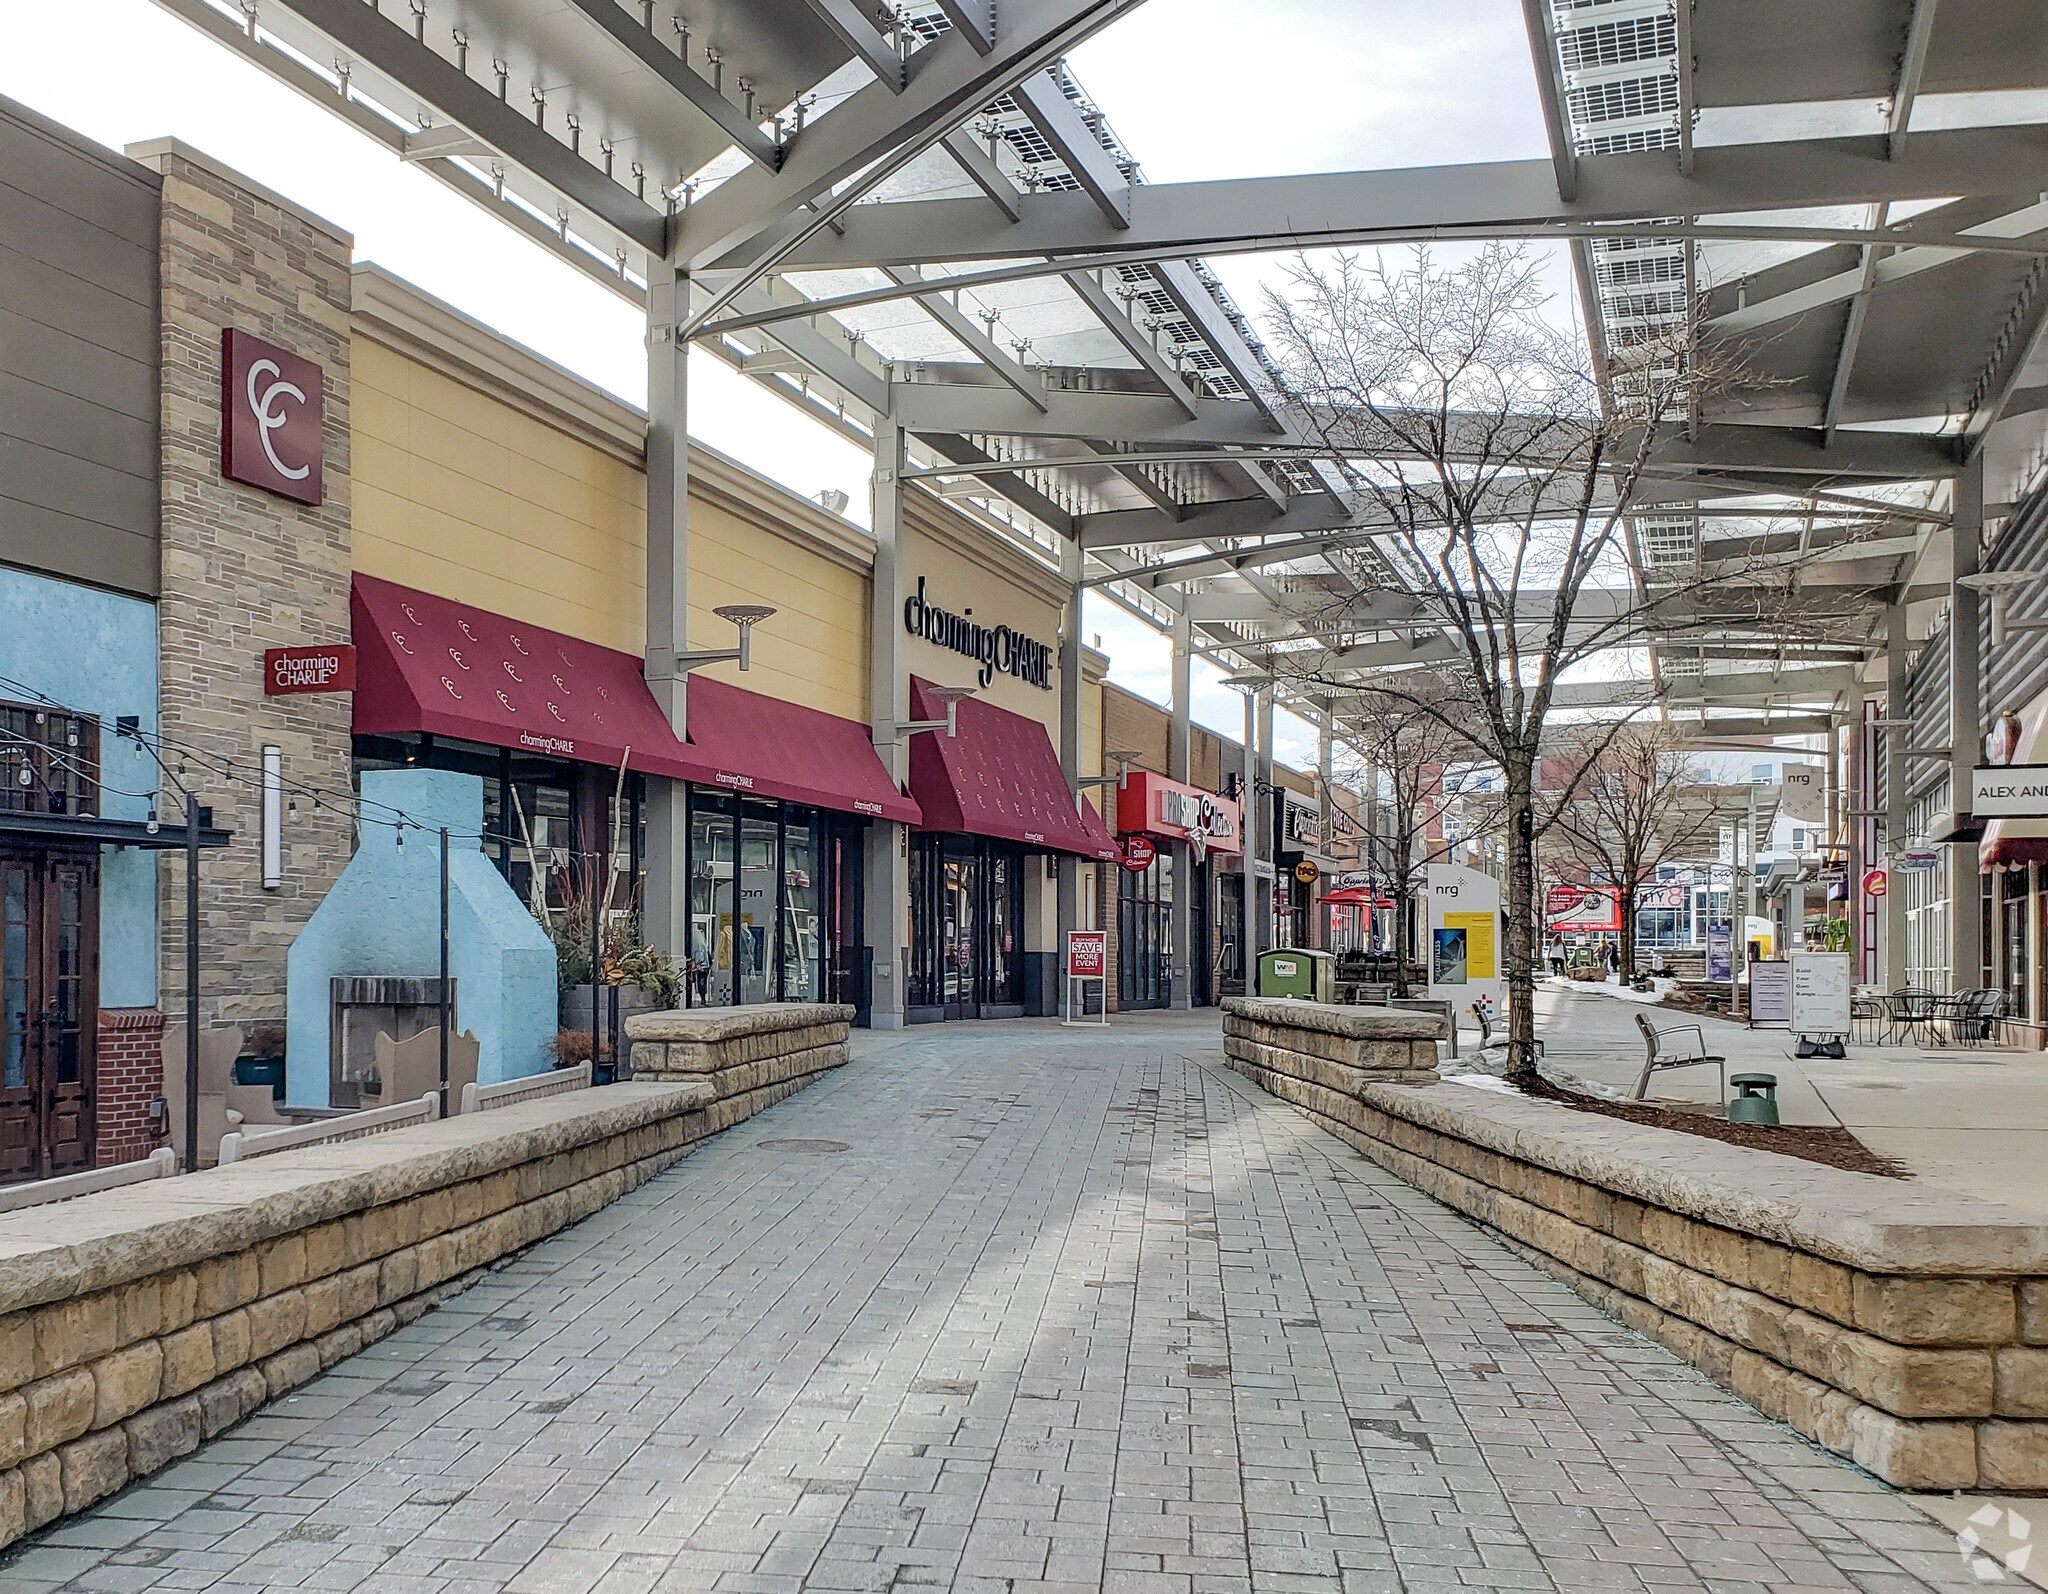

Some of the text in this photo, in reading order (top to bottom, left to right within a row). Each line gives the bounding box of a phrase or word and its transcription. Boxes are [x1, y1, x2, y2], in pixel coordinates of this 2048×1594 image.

[274, 653, 339, 675] charming
[276, 669, 330, 687] CHARLIE
[1788, 774, 1810, 786] nrg
[1978, 786, 2016, 799] ALEX
[1133, 849, 1152, 858] SHOP
[1435, 885, 1459, 898] nrg
[1073, 943, 1101, 952] SAVE
